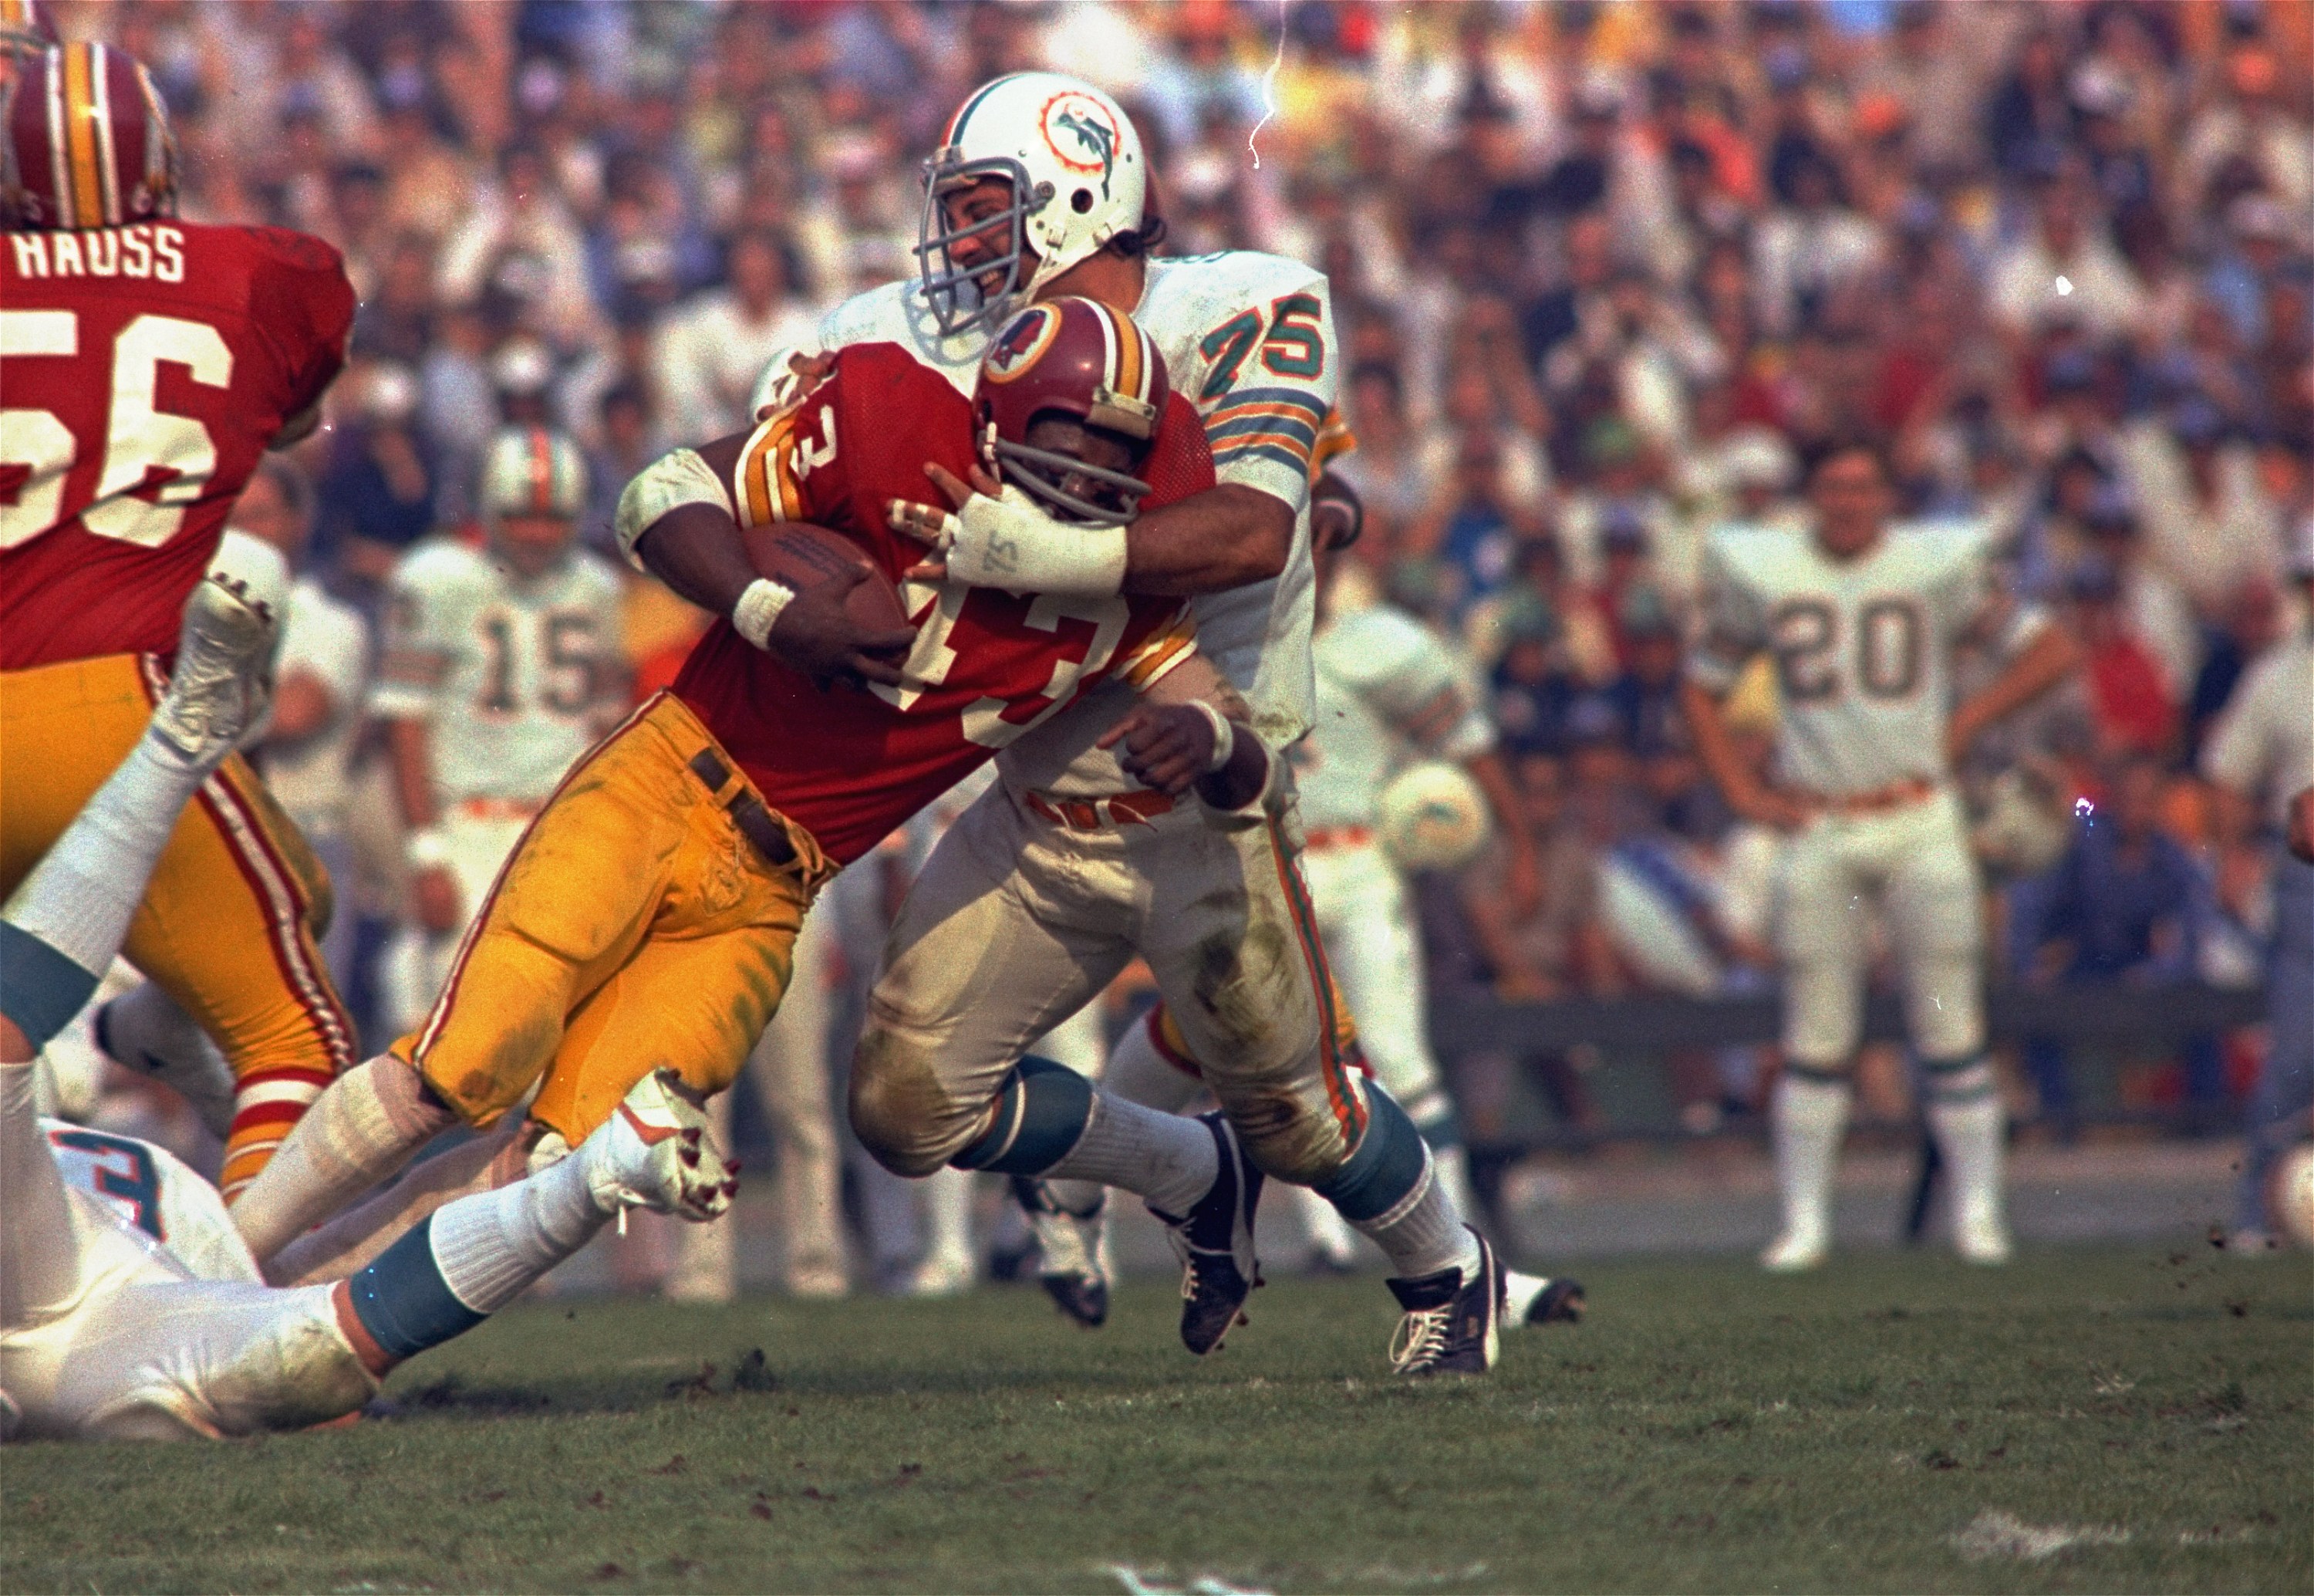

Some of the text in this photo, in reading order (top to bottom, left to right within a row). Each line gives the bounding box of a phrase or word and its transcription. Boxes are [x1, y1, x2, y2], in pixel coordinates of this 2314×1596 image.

[11, 224, 184, 283] HAUSS
[1199, 292, 1325, 405] 75
[0, 310, 234, 549] 56
[982, 529, 1018, 573] 75
[475, 612, 599, 716] 15
[1774, 596, 1924, 701] 20
